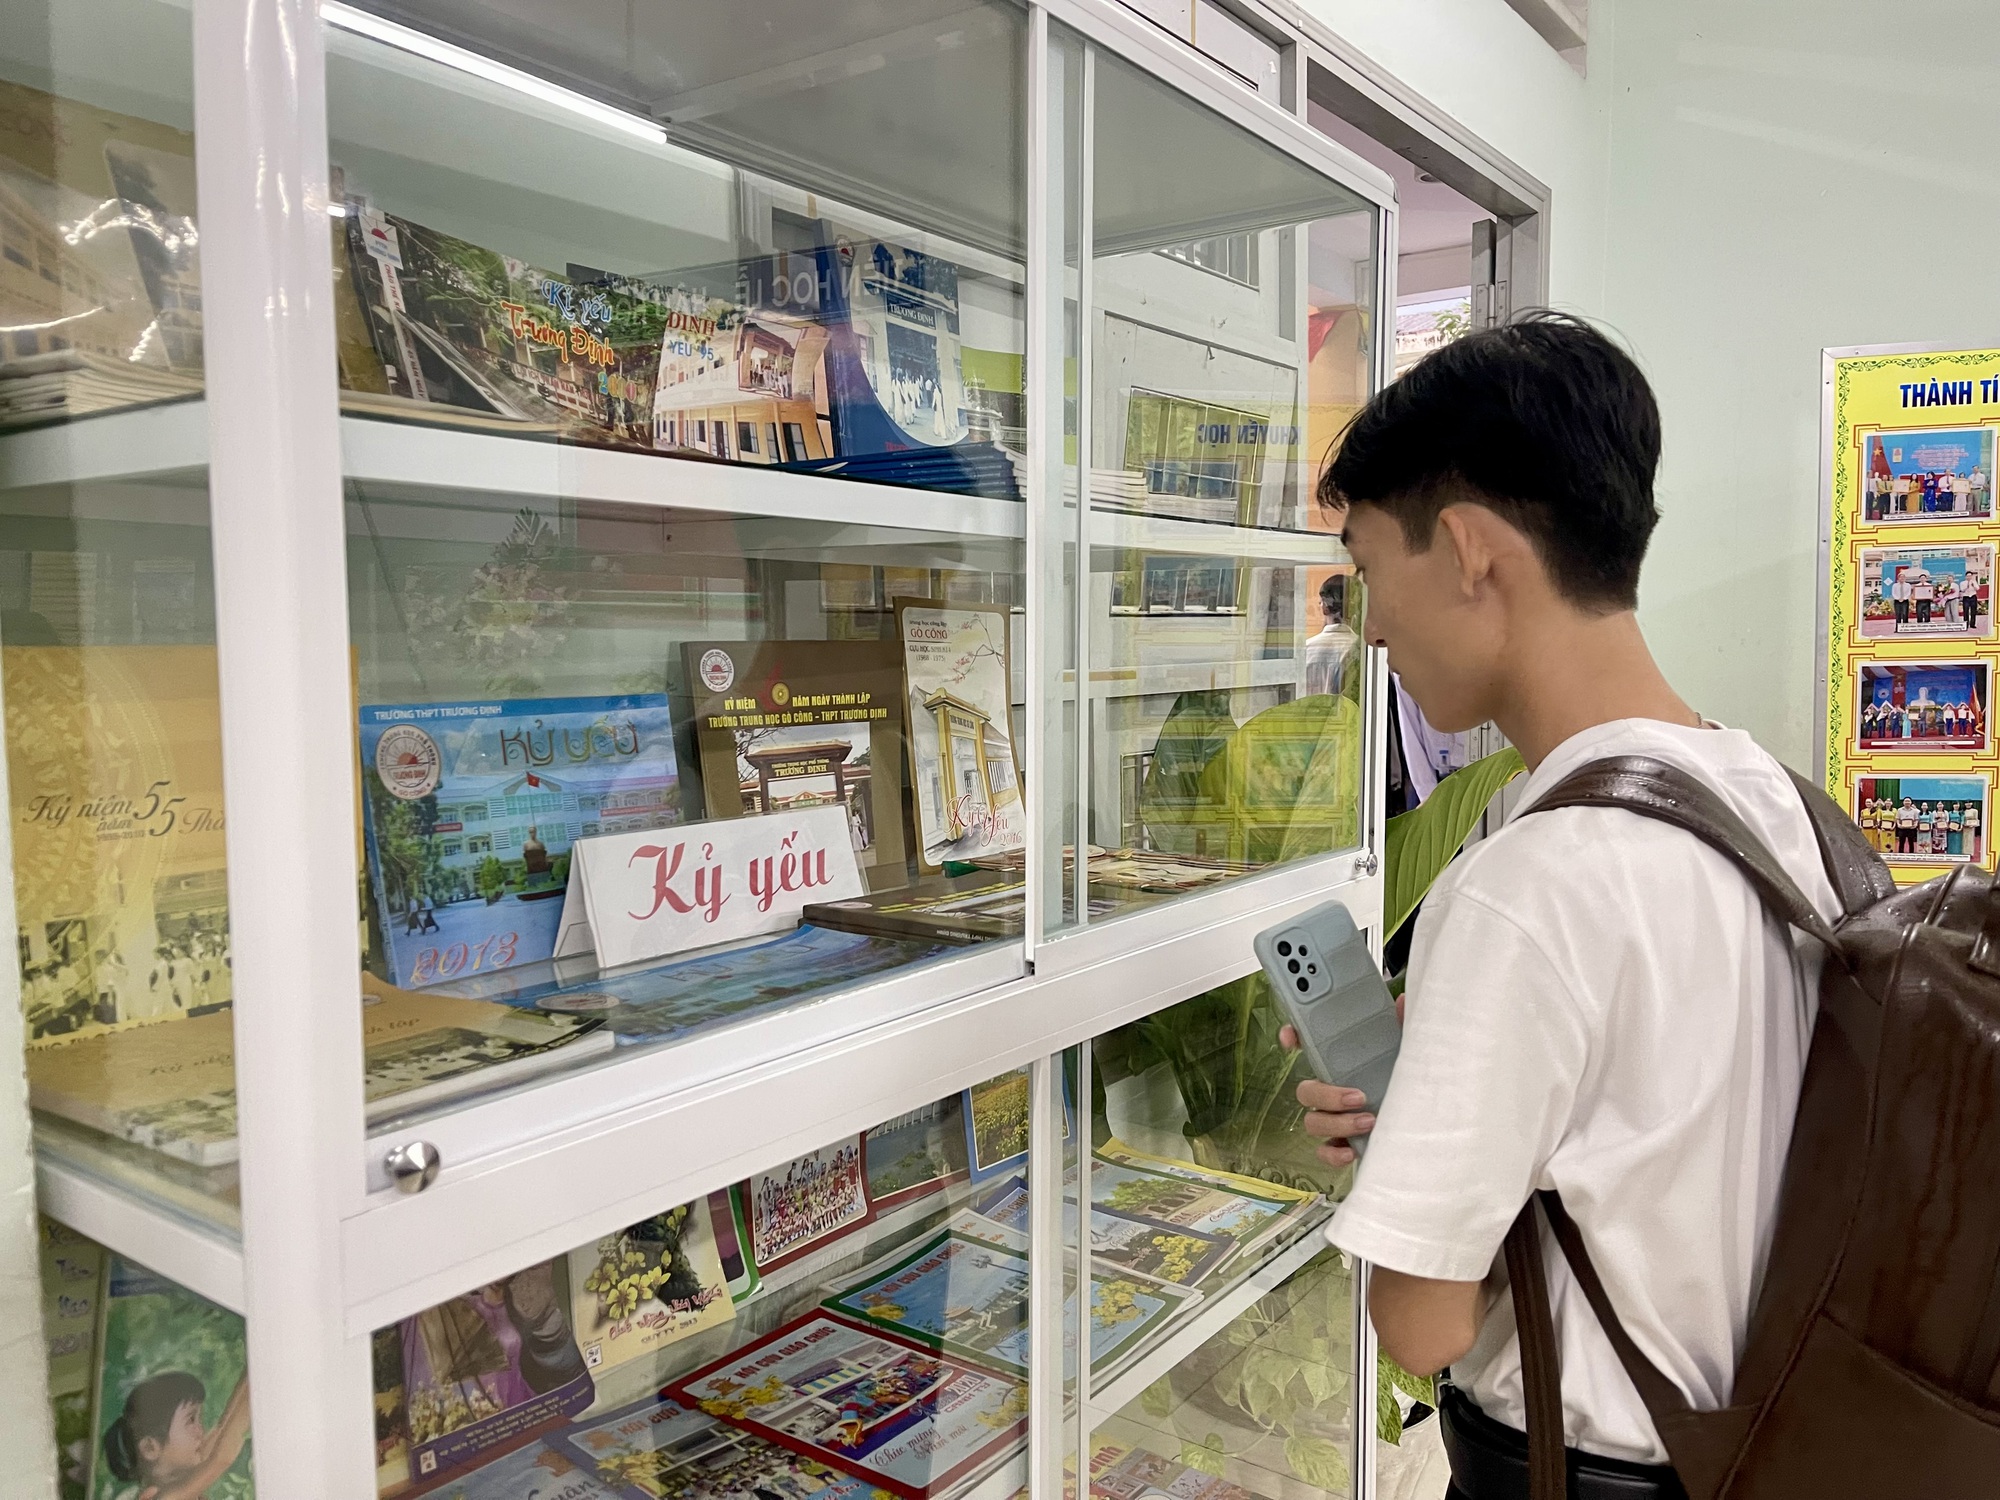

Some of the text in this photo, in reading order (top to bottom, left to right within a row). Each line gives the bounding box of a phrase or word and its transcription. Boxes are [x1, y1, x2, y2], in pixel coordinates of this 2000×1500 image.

[580, 294, 613, 325] yếu
[917, 312, 934, 325] ĐỊNH
[500, 300, 615, 368] Trương Định
[1900, 374, 2000, 408] THÀNH TÍ
[910, 626, 948, 640] GÒ CÔNG
[415, 708, 439, 719] THPT
[479, 705, 502, 715] ĐỊNH
[736, 697, 756, 712] NIỆM
[792, 695, 810, 708] NĂM
[811, 693, 831, 707] NGÀY
[832, 693, 856, 706] THÀNH
[857, 692, 871, 705] LẬP
[739, 714, 763, 727] TRUNG
[765, 714, 780, 727] HỌC
[782, 711, 792, 724] GÒ
[793, 710, 814, 723] CÔNG
[821, 711, 839, 722] THPT
[840, 709, 868, 721] TRƯƠNG
[869, 708, 887, 721] ĐỊNH
[807, 764, 827, 775] ĐỊNH
[628, 831, 834, 923] Kỷ yếu
[755, 1353, 784, 1367] CỰU
[778, 1341, 809, 1356] GIÁO
[804, 1326, 837, 1343] CHỨC
